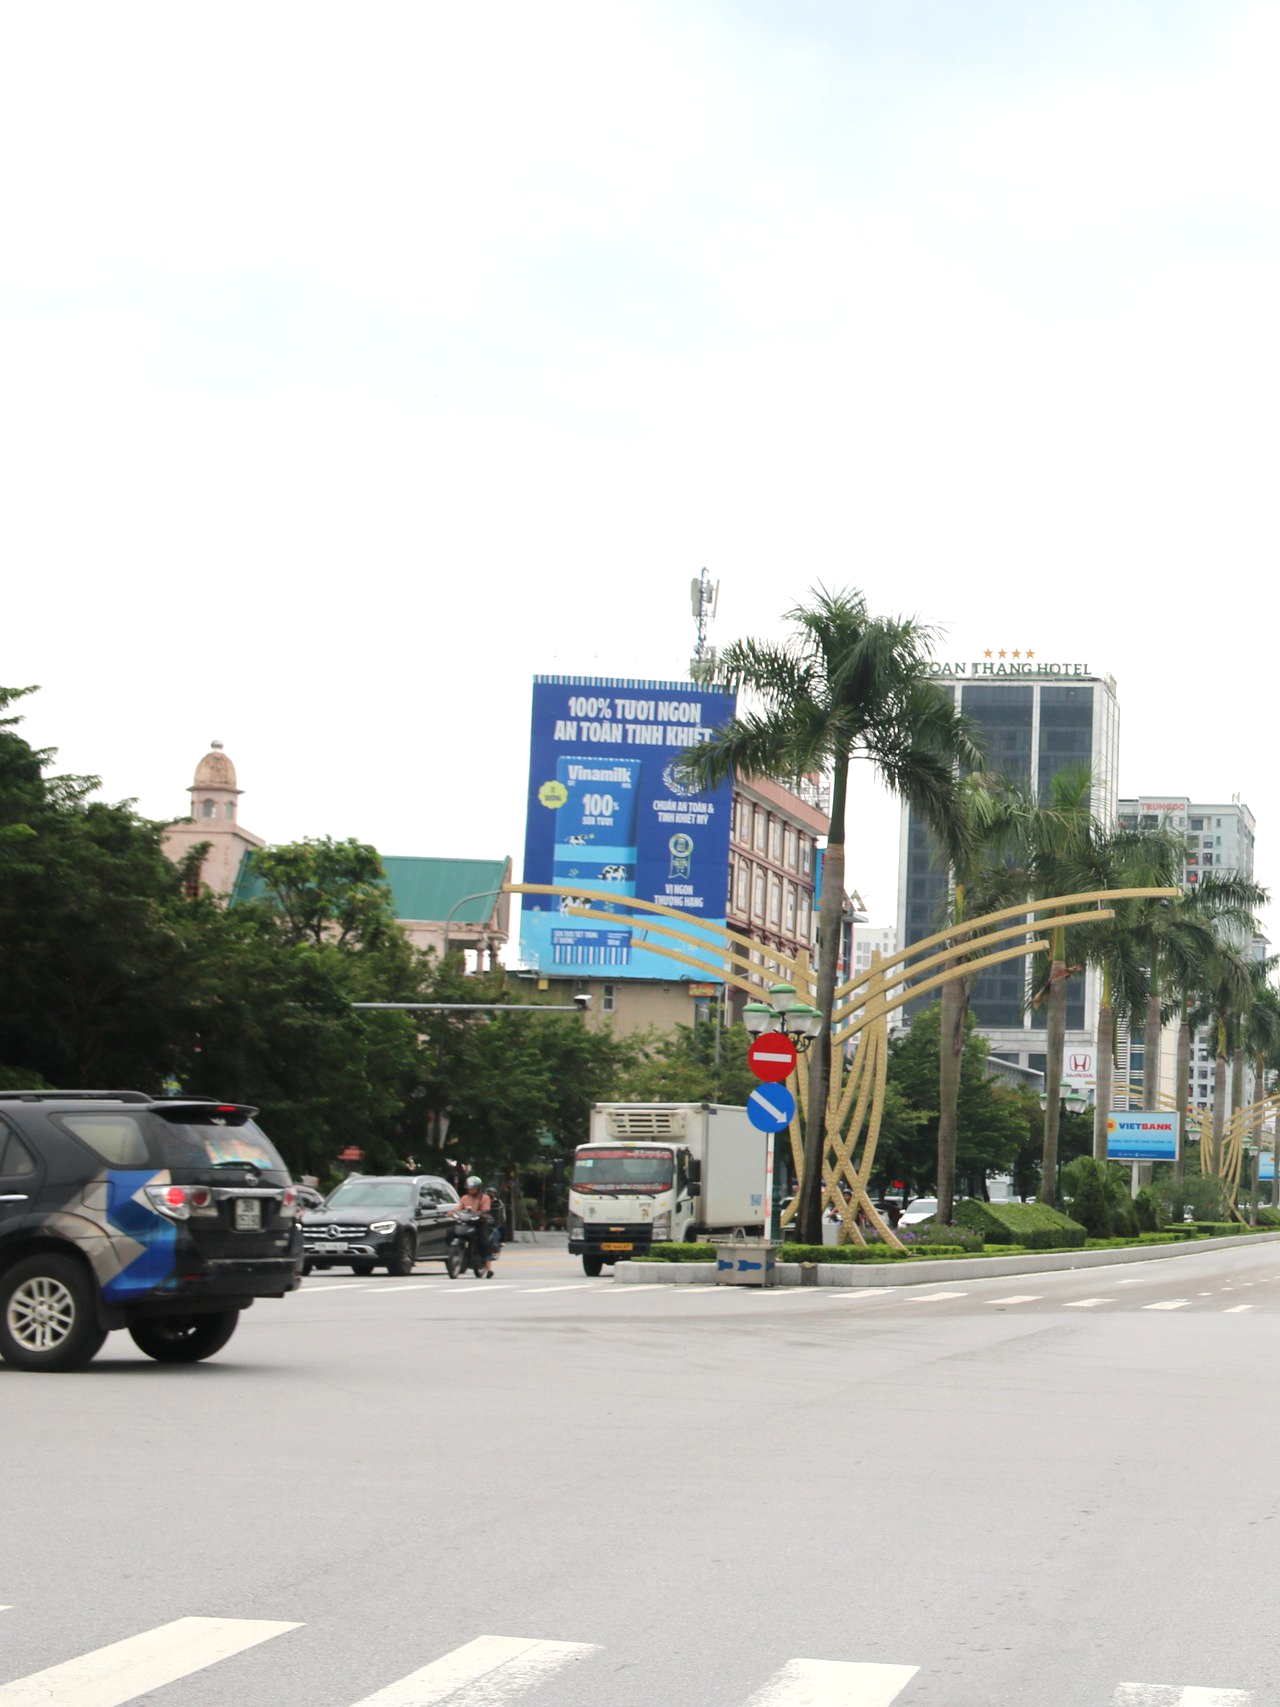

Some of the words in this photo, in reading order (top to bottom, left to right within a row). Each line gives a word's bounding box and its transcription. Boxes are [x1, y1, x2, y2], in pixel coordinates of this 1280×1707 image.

[1037, 663, 1092, 675] HOTEL
[568, 696, 612, 718] 100%
[614, 699, 655, 720] TƯƠI
[658, 701, 702, 723] NGON
[554, 720, 577, 741] AN
[580, 720, 623, 744] TOÀN
[625, 724, 663, 745] TINH
[567, 764, 632, 783] Vinamilk
[678, 801, 688, 812] AN
[688, 801, 707, 813] TOÀN
[708, 803, 715, 814] &
[658, 812, 675, 823] TINH
[674, 884, 694, 895] NGON
[684, 896, 704, 908] HẠNG
[1119, 1122, 1172, 1131] VIETBANK
